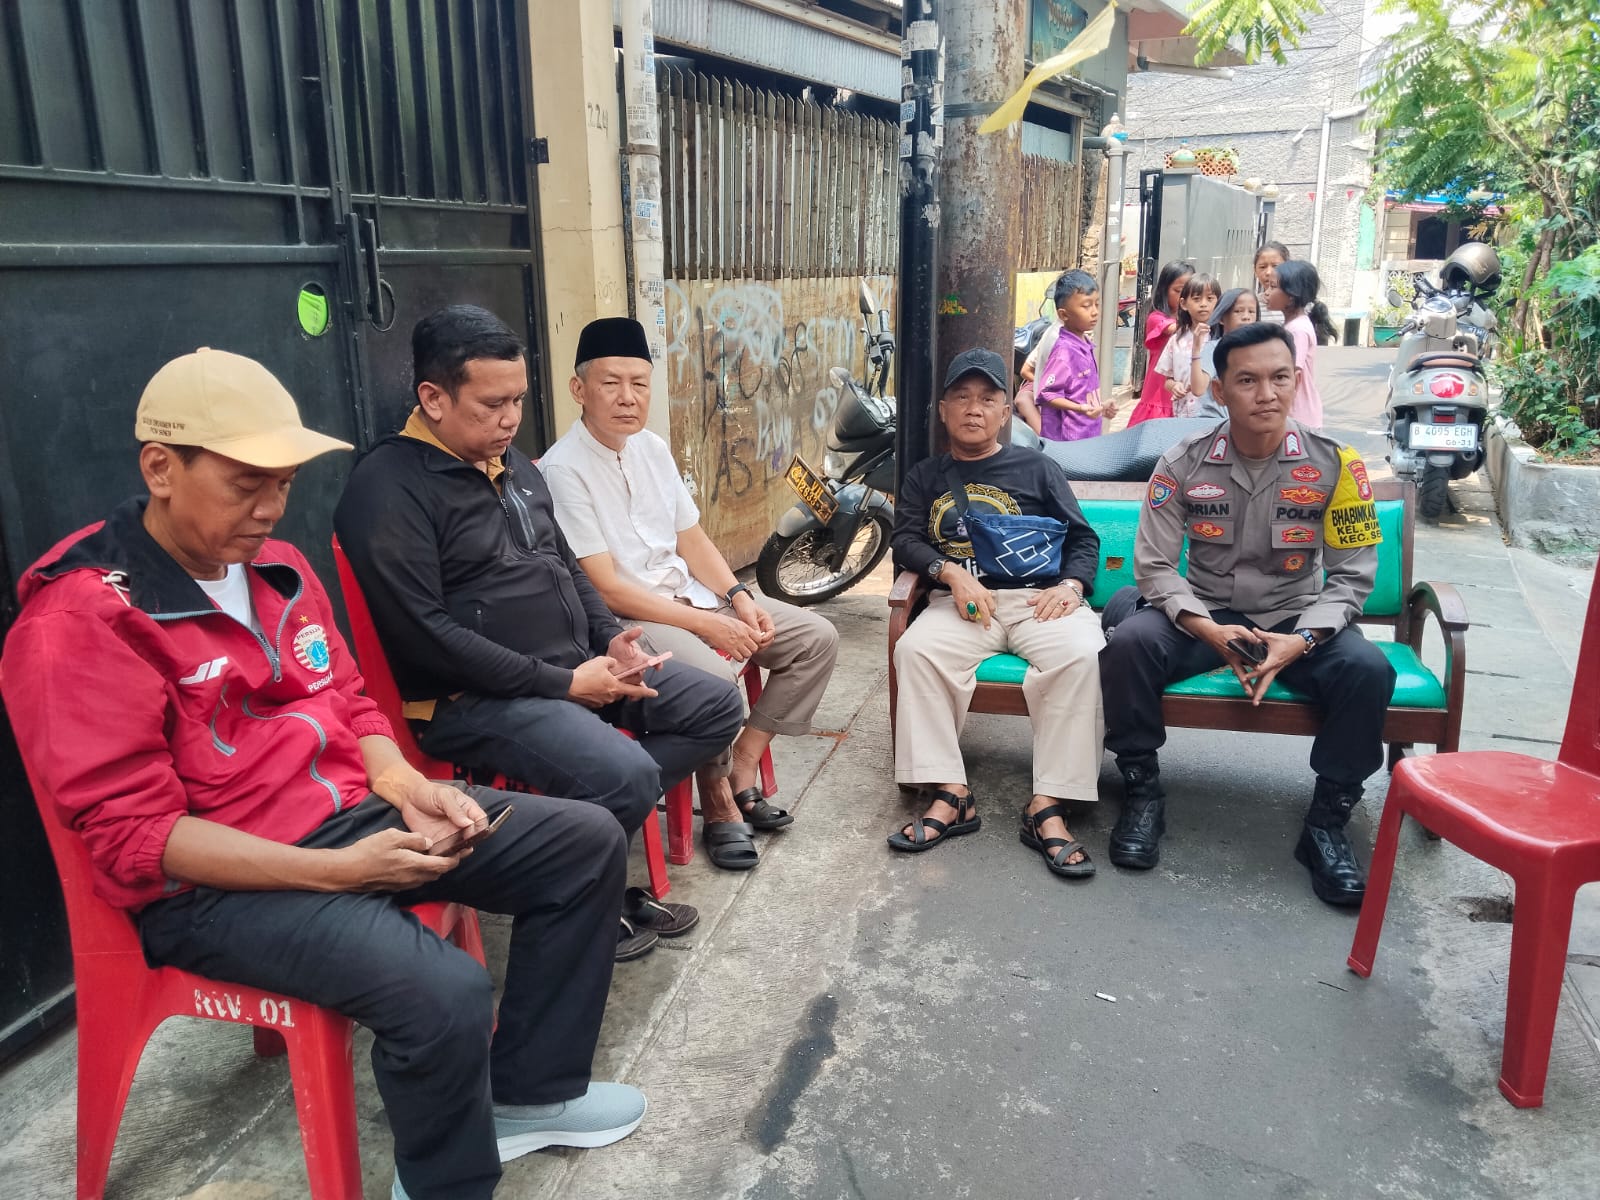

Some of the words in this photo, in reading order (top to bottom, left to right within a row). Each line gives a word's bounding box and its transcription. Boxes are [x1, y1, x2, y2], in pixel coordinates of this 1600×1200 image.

[1414, 425, 1420, 436] B
[1425, 426, 1450, 436] 4095
[1454, 427, 1473, 437] EGH
[1276, 507, 1323, 520] POLRI
[1337, 525, 1363, 536] KEL.
[1339, 533, 1369, 544] KEC.
[260, 998, 295, 1028] 01
